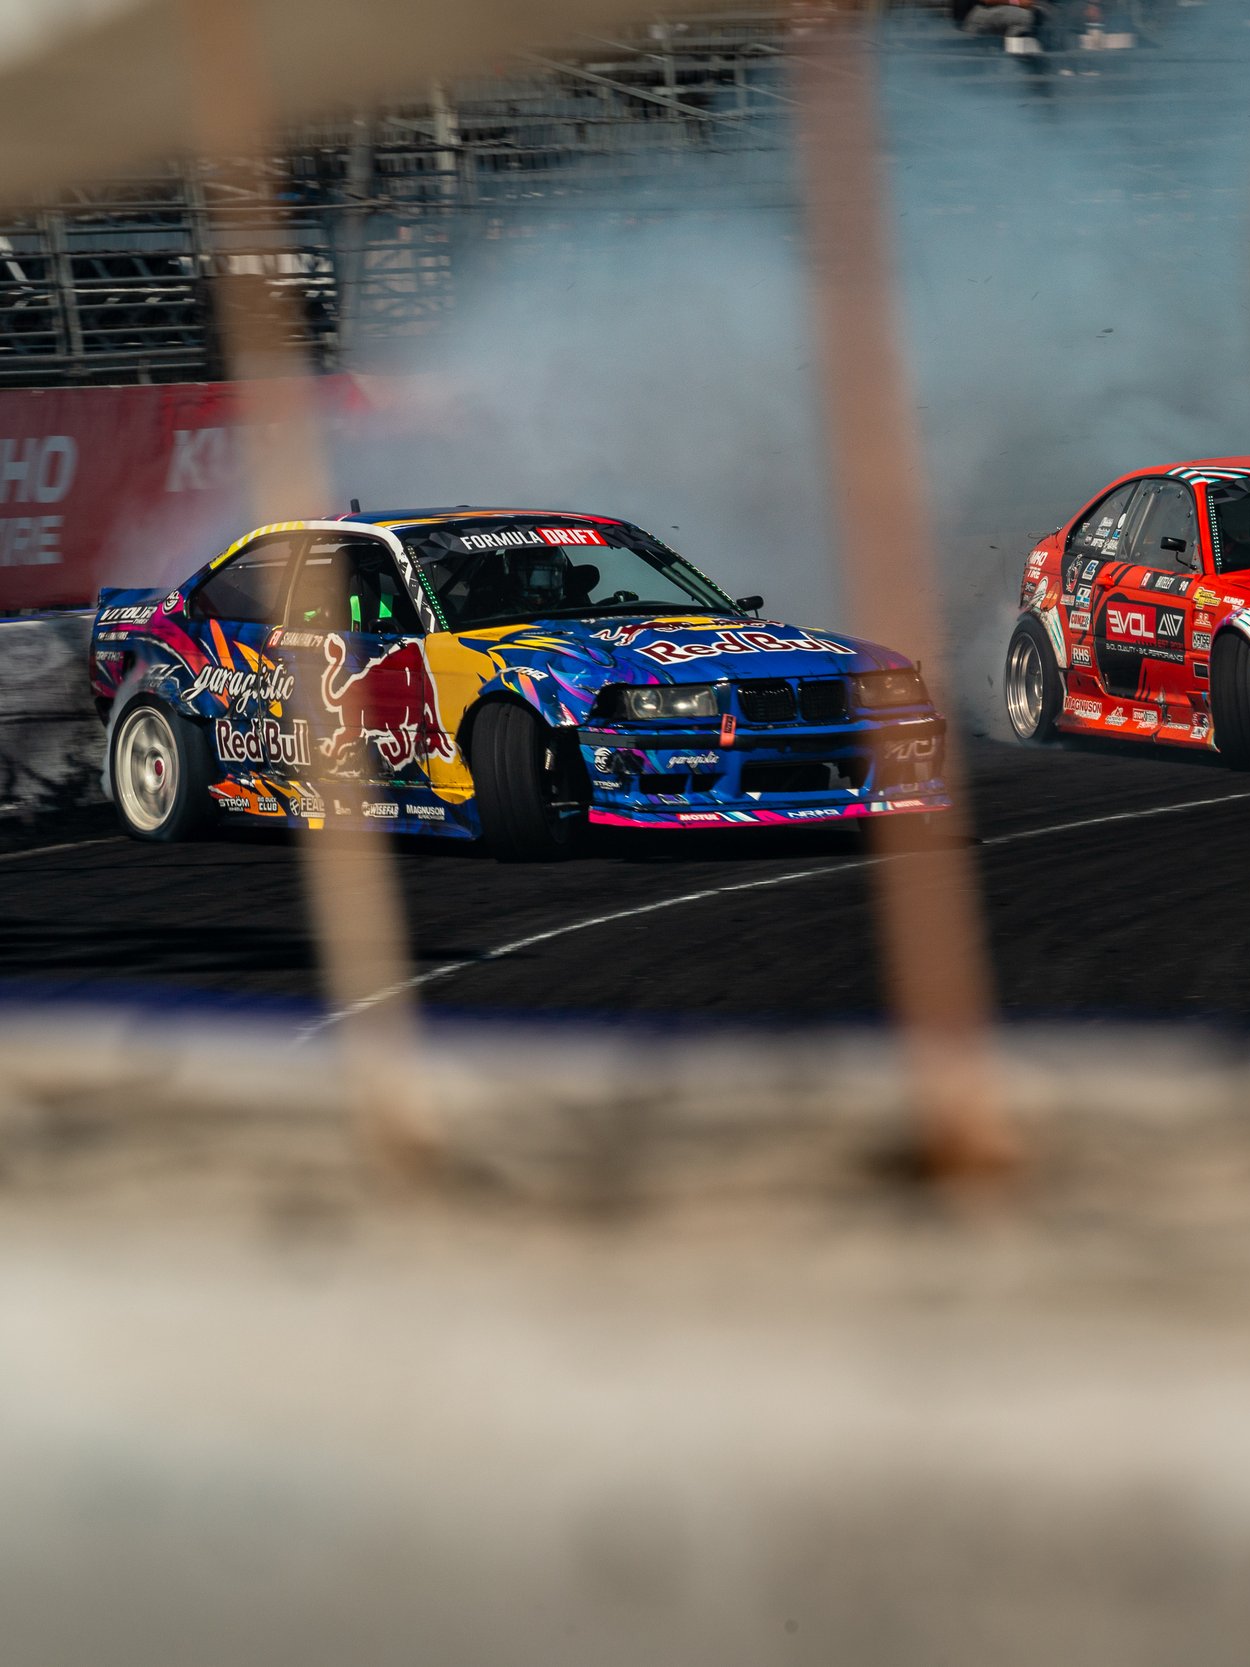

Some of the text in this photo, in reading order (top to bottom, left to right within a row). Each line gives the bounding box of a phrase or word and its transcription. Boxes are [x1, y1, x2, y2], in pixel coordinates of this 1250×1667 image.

[460, 529, 601, 550] FORMULA DRIFT
[100, 606, 157, 620] VITOUR
[635, 631, 857, 665] Red Bull
[1073, 648, 1089, 661] RHS
[181, 660, 295, 713] garagistic
[215, 718, 311, 765] Red Bull
[219, 795, 250, 807] STRÖM
[259, 803, 278, 811] CLUB
[406, 804, 445, 816] MAGNUSON
